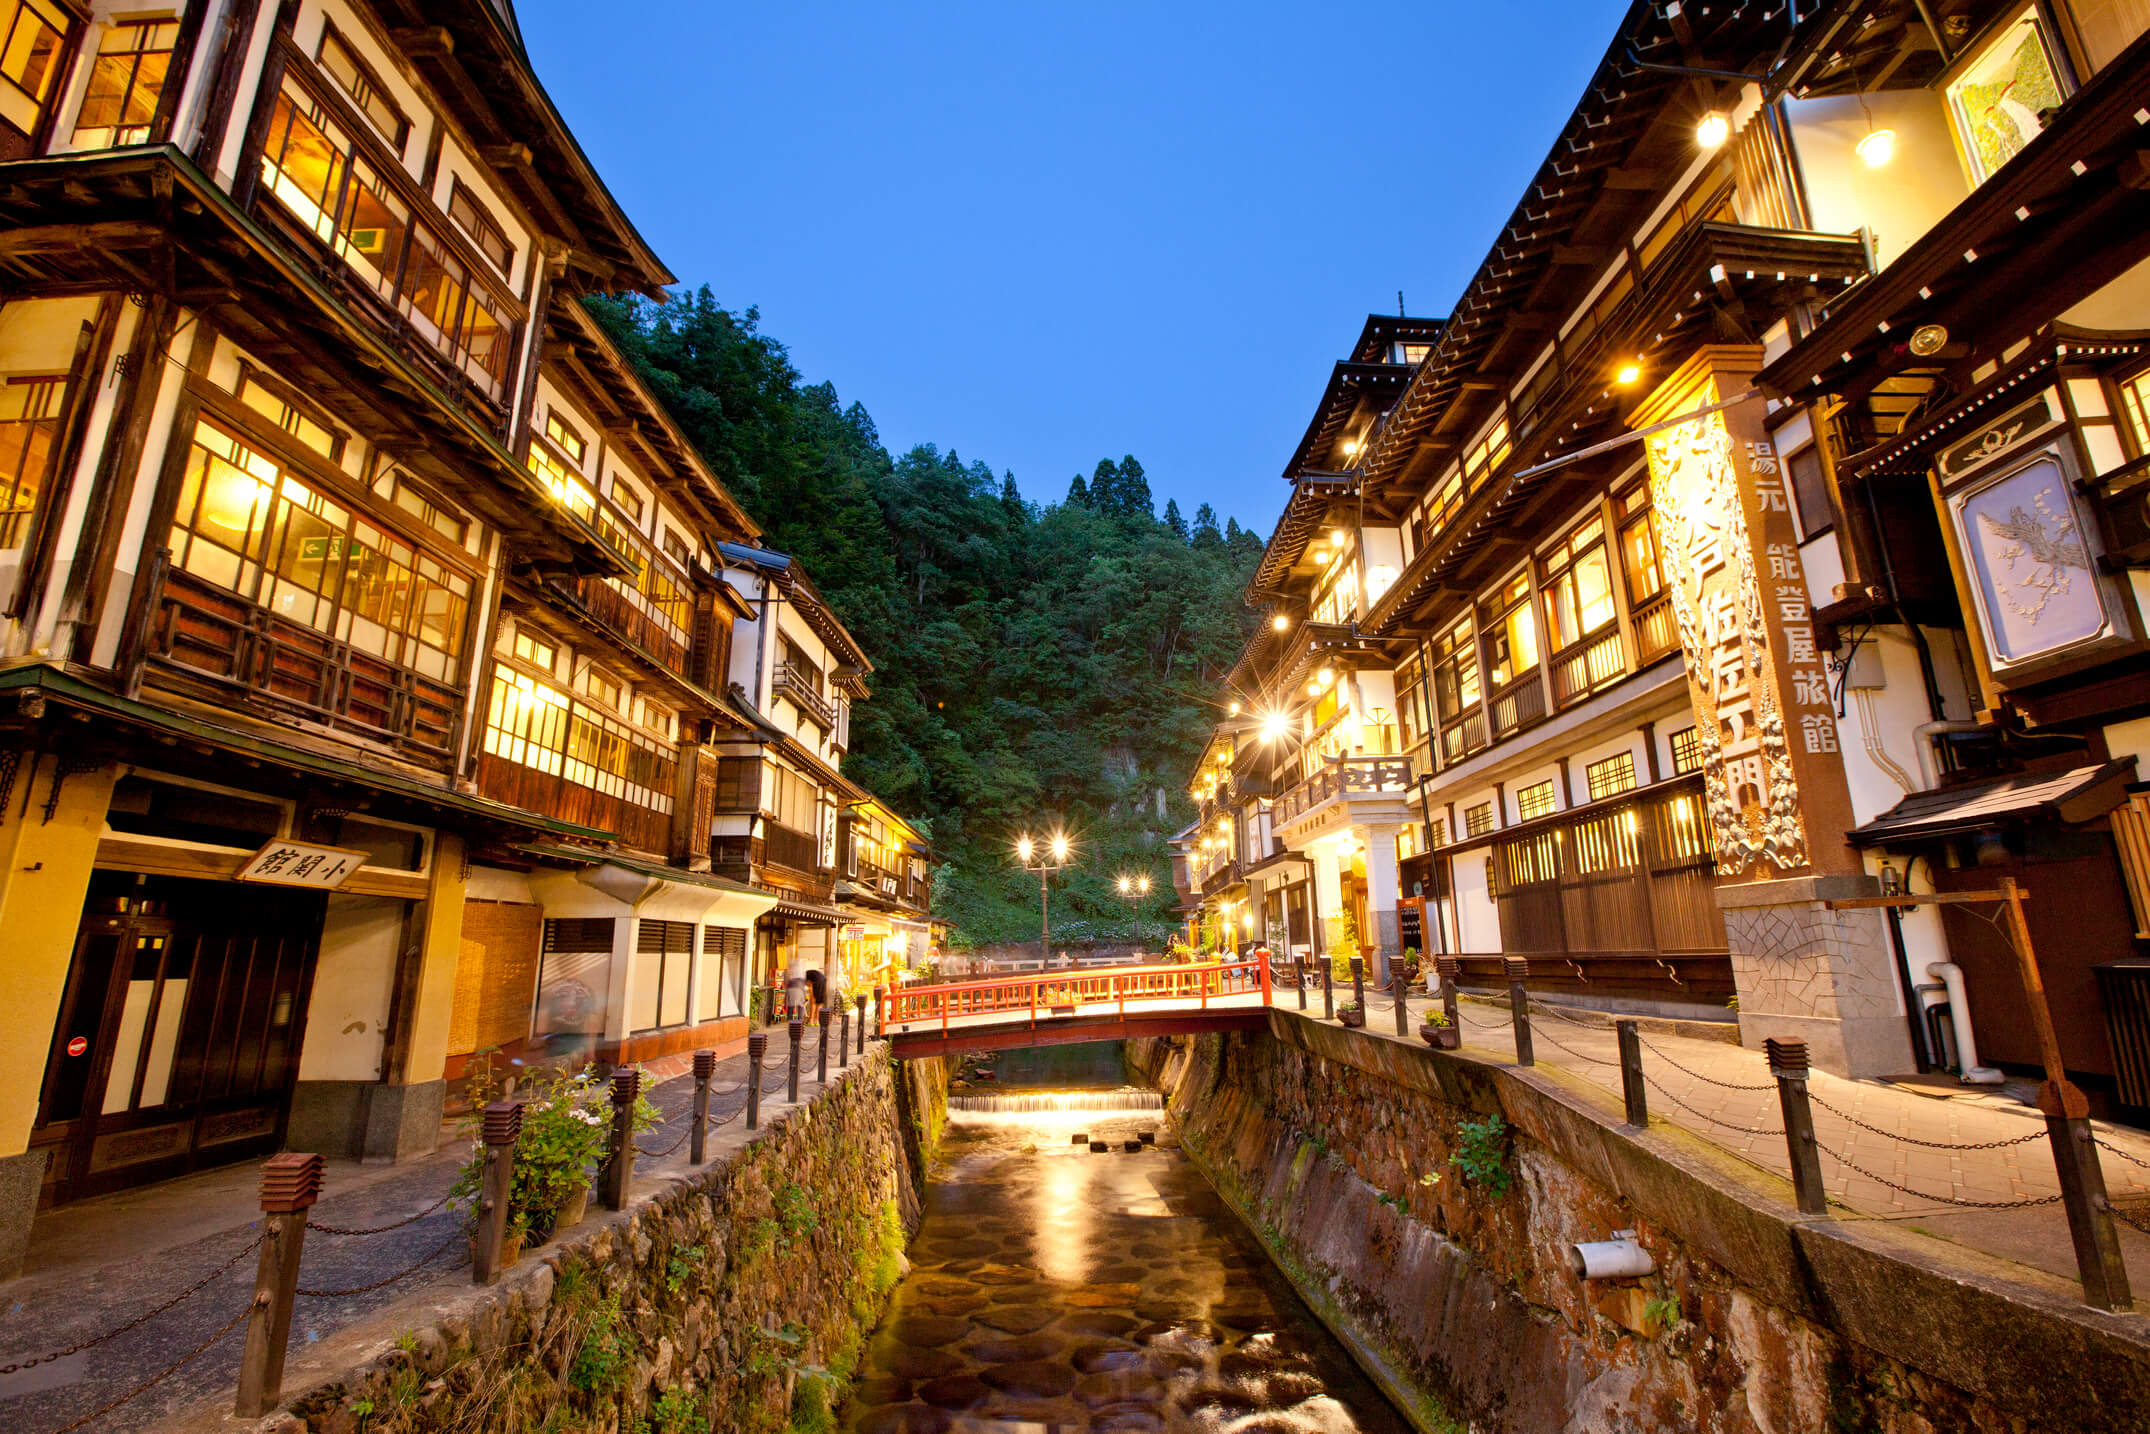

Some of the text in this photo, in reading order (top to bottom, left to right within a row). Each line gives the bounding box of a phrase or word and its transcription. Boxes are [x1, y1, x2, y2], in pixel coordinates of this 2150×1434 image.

[1745, 442, 1838, 754] 湯元 能登屋旅館
